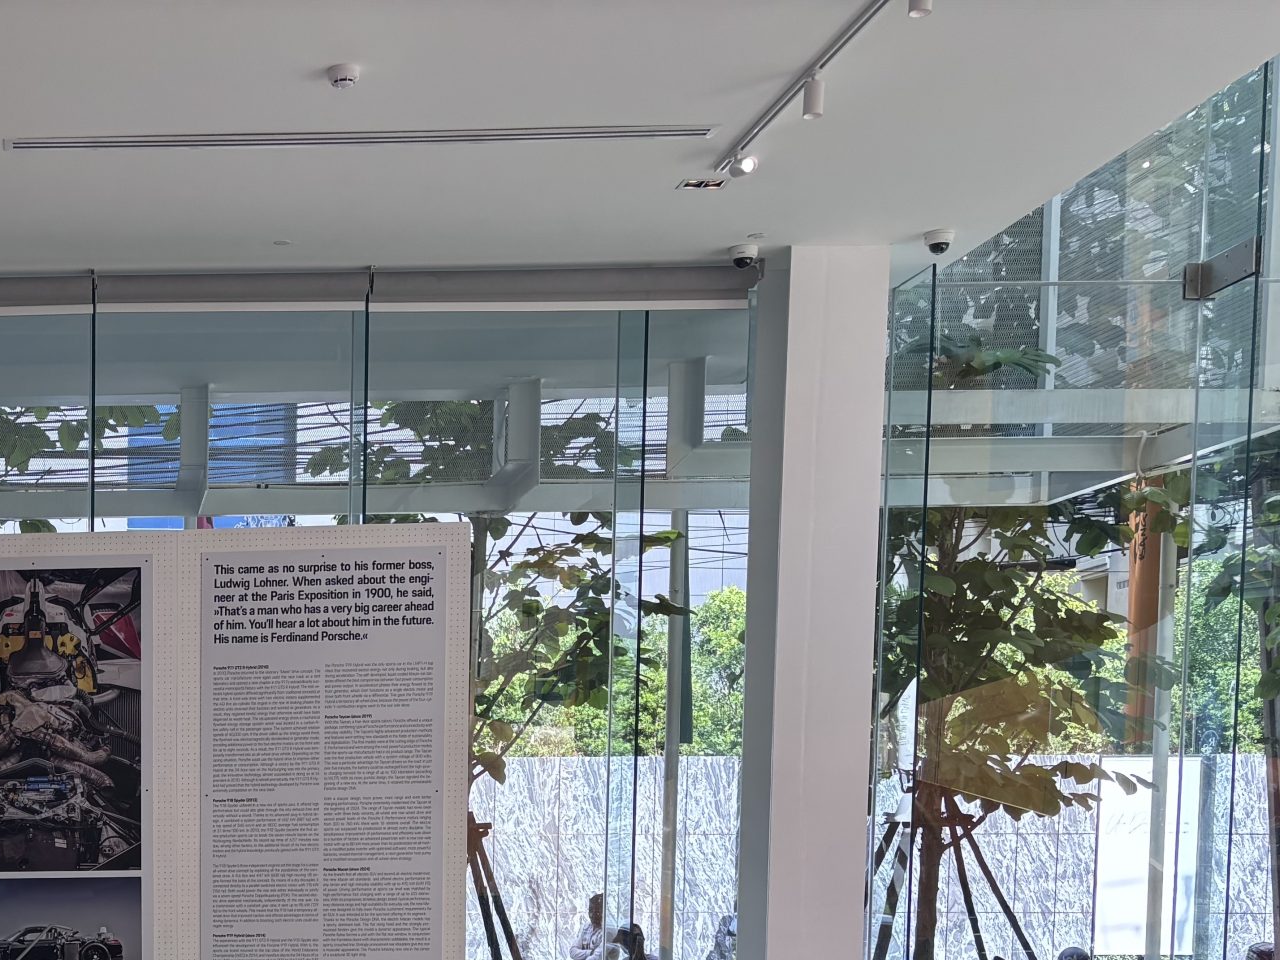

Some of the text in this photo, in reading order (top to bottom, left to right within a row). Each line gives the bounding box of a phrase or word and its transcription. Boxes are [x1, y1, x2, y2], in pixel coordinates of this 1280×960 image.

[214, 564, 234, 575] This
[238, 566, 265, 574] came
[268, 566, 279, 574] as
[298, 562, 337, 575] surprise
[340, 562, 351, 571] to
[355, 561, 368, 571] his
[372, 561, 405, 570] former
[409, 560, 434, 570] boss,
[214, 574, 434, 590] Ludwig Lohner. When asked about the engi-
[214, 588, 434, 603] neer at the Paris Exposition in 1900, he said,
[214, 606, 247, 616] »That's
[257, 607, 278, 615] man
[280, 604, 302, 615] who
[304, 604, 321, 614] has
[331, 605, 352, 616] very
[355, 603, 370, 615] big
[372, 604, 402, 612] career
[404, 601, 434, 611] ahead
[214, 620, 224, 630] of
[226, 619, 246, 630] him.
[249, 618, 274, 629] You'll
[276, 618, 297, 629] hear
[307, 618, 320, 628] lot
[322, 617, 350, 628] about
[352, 616, 370, 626] him
[373, 616, 381, 626] in
[383, 616, 400, 626] the
[402, 615, 434, 625] future.
[214, 630, 368, 644] His name is Ferdinand Porsche.«
